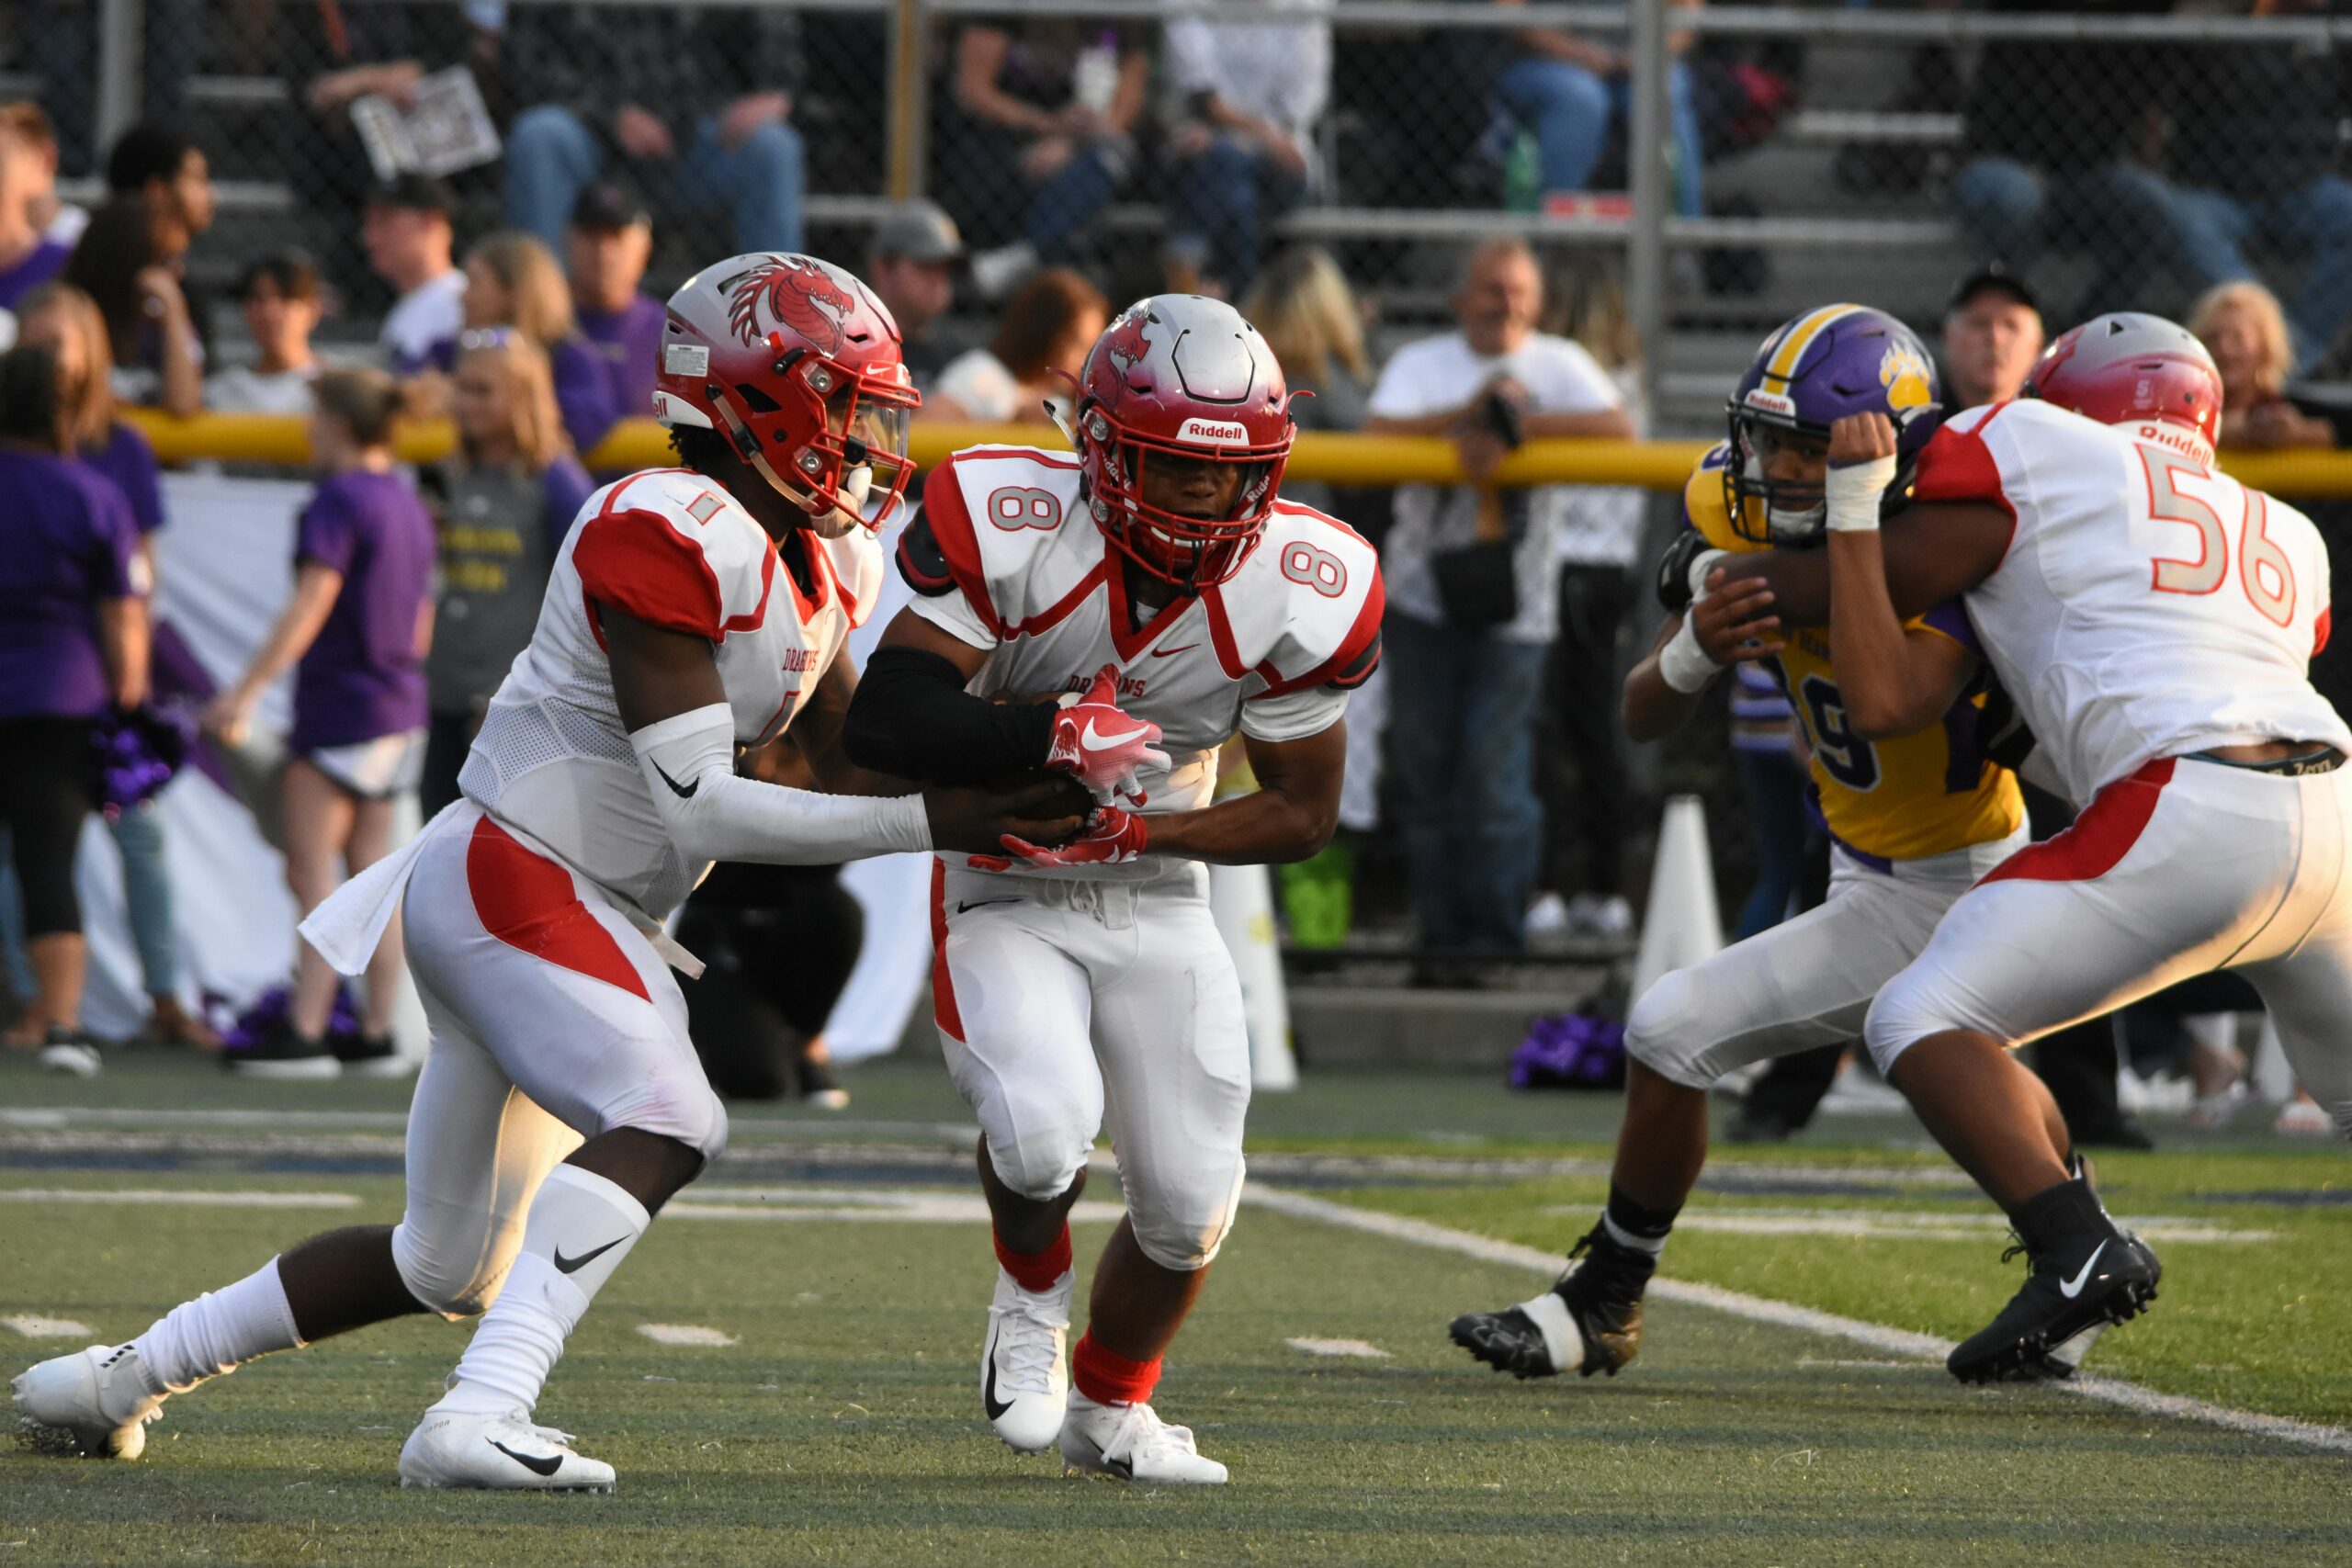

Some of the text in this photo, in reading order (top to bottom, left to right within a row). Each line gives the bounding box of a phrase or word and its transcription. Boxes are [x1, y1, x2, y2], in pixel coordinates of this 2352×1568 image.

[1189, 423, 1242, 440] Riddell
[988, 485, 1062, 532] 8
[2132, 441, 2297, 629] 56
[1280, 540, 1348, 599] 8
[1066, 673, 1148, 698] DRNS
